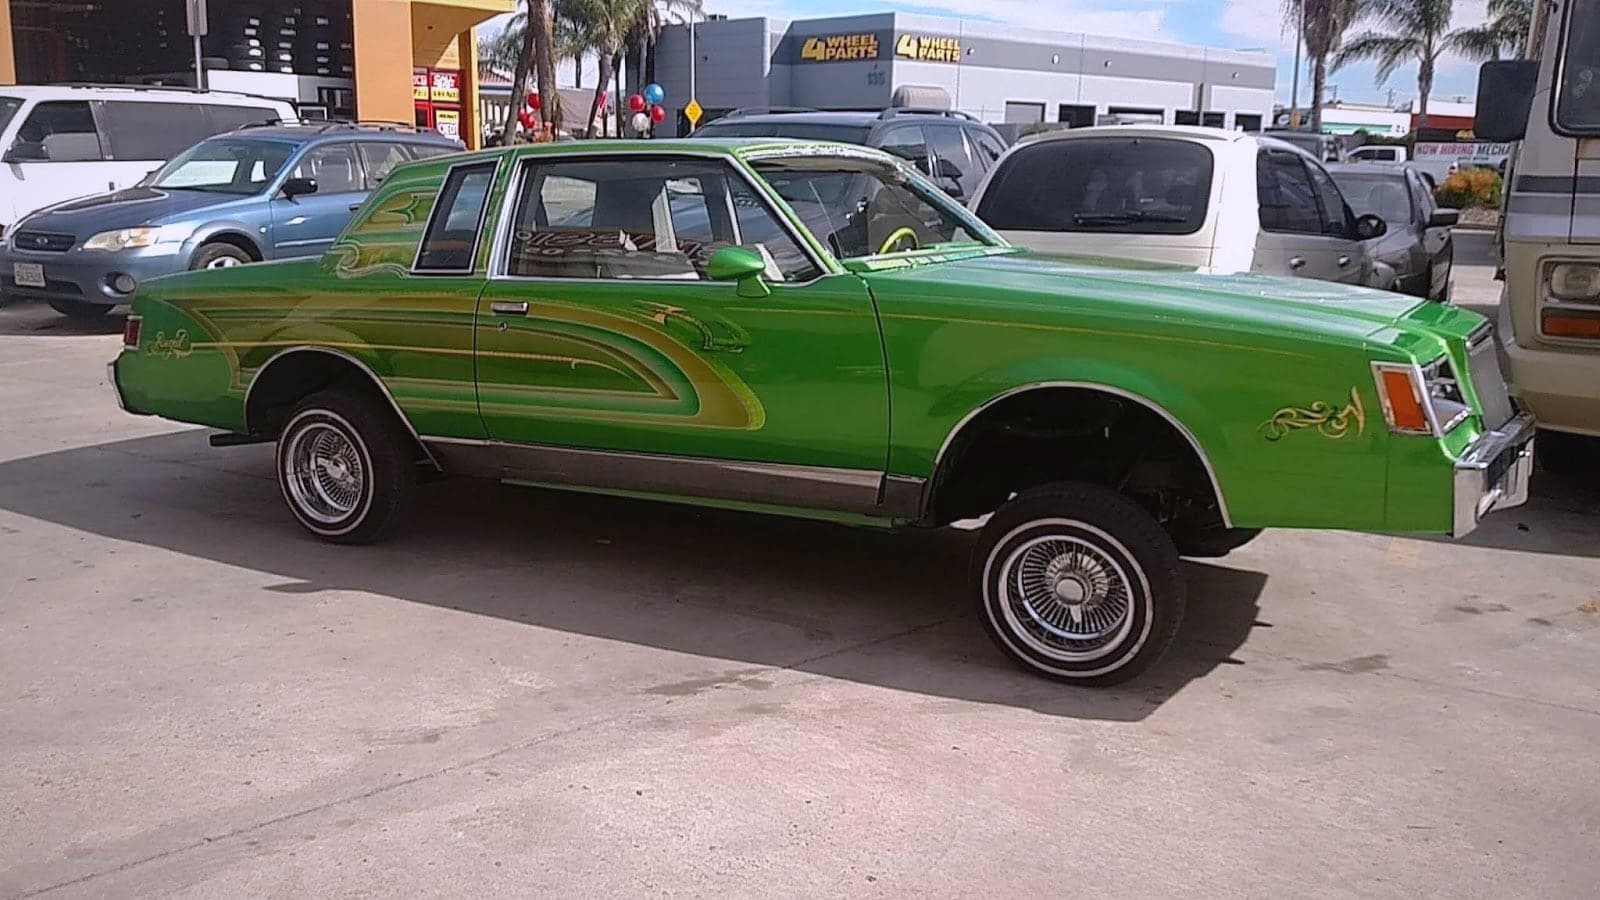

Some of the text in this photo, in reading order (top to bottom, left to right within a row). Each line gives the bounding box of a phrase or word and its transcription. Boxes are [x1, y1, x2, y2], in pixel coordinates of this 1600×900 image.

[802, 34, 879, 61] 4 WHEEL
[825, 47, 879, 60] PARTS
[896, 34, 961, 60] 4 WHEEL
[918, 48, 961, 62] PARTS
[1417, 144, 1437, 155] NOW
[1440, 144, 1474, 155] HIRING
